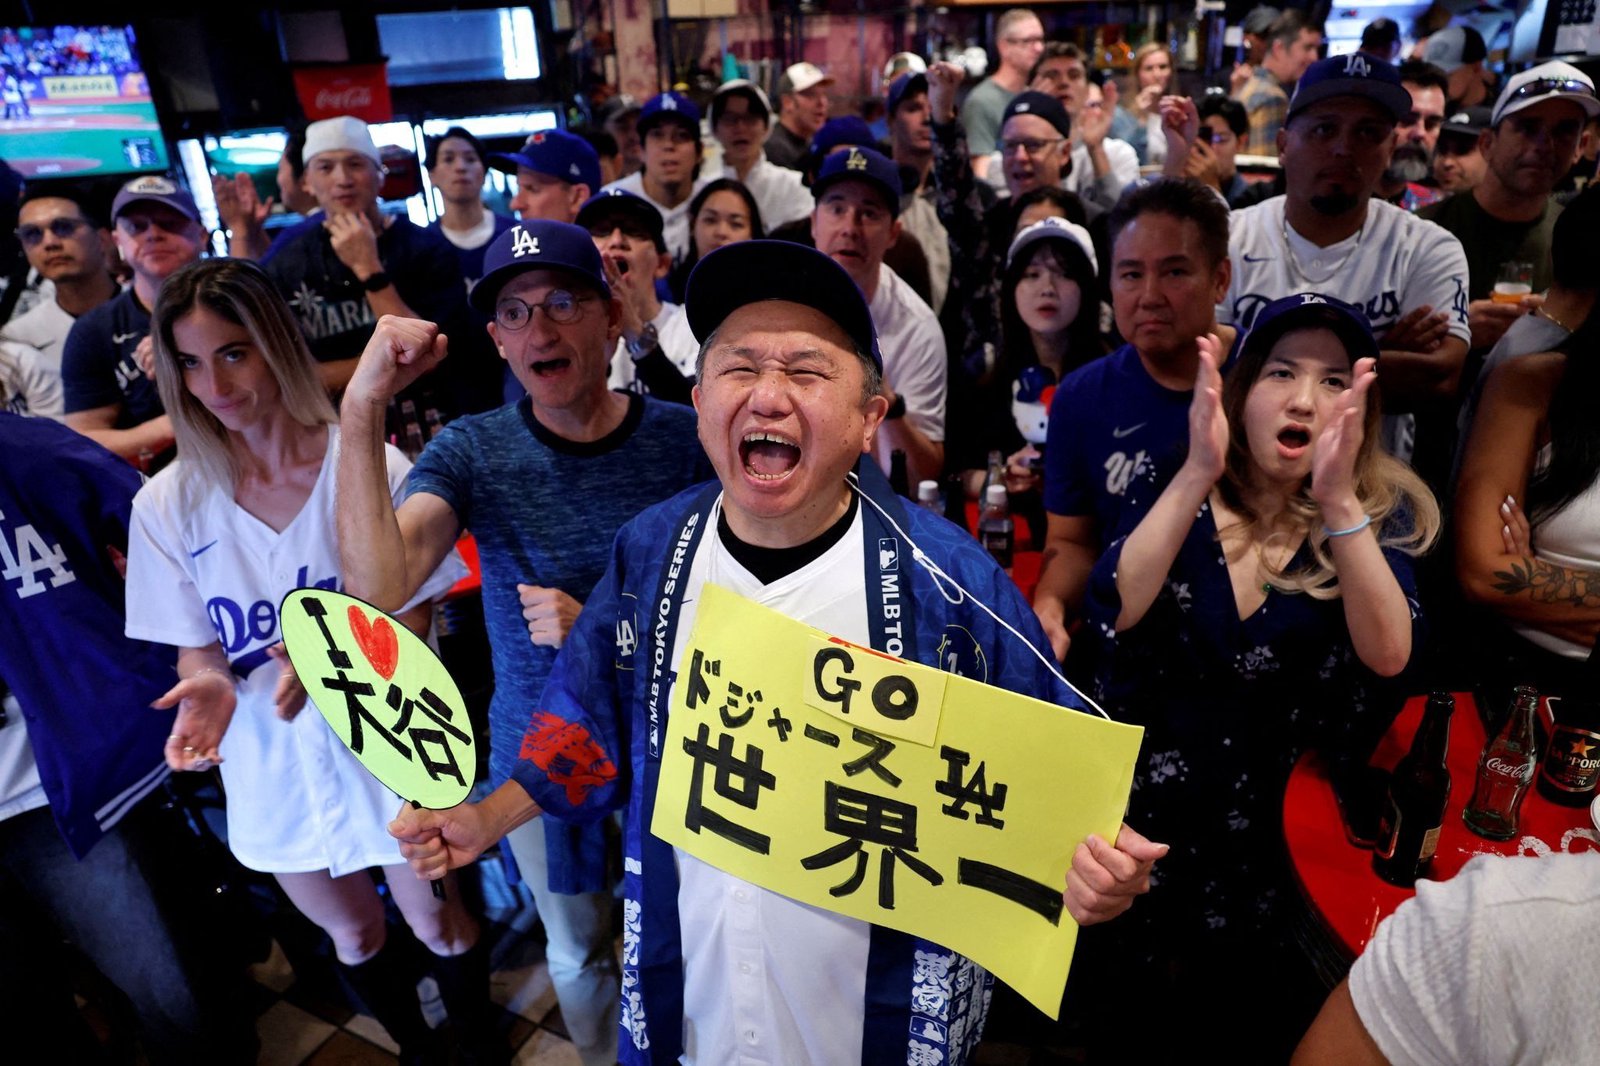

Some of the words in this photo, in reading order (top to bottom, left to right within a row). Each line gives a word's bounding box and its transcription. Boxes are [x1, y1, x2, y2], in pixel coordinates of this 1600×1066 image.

[846, 147, 867, 170] LA
[511, 225, 541, 258] LA
[303, 300, 374, 340] MARI
[664, 512, 699, 596] SERIES
[881, 574, 901, 619] MLB
[300, 597, 353, 669] I
[653, 597, 671, 679] TOKYO
[885, 621, 904, 657] TO
[321, 669, 472, 787] 大谷
[650, 683, 660, 724] MLB
[685, 648, 902, 788] ドジャース
[683, 722, 1064, 926] 世界一
